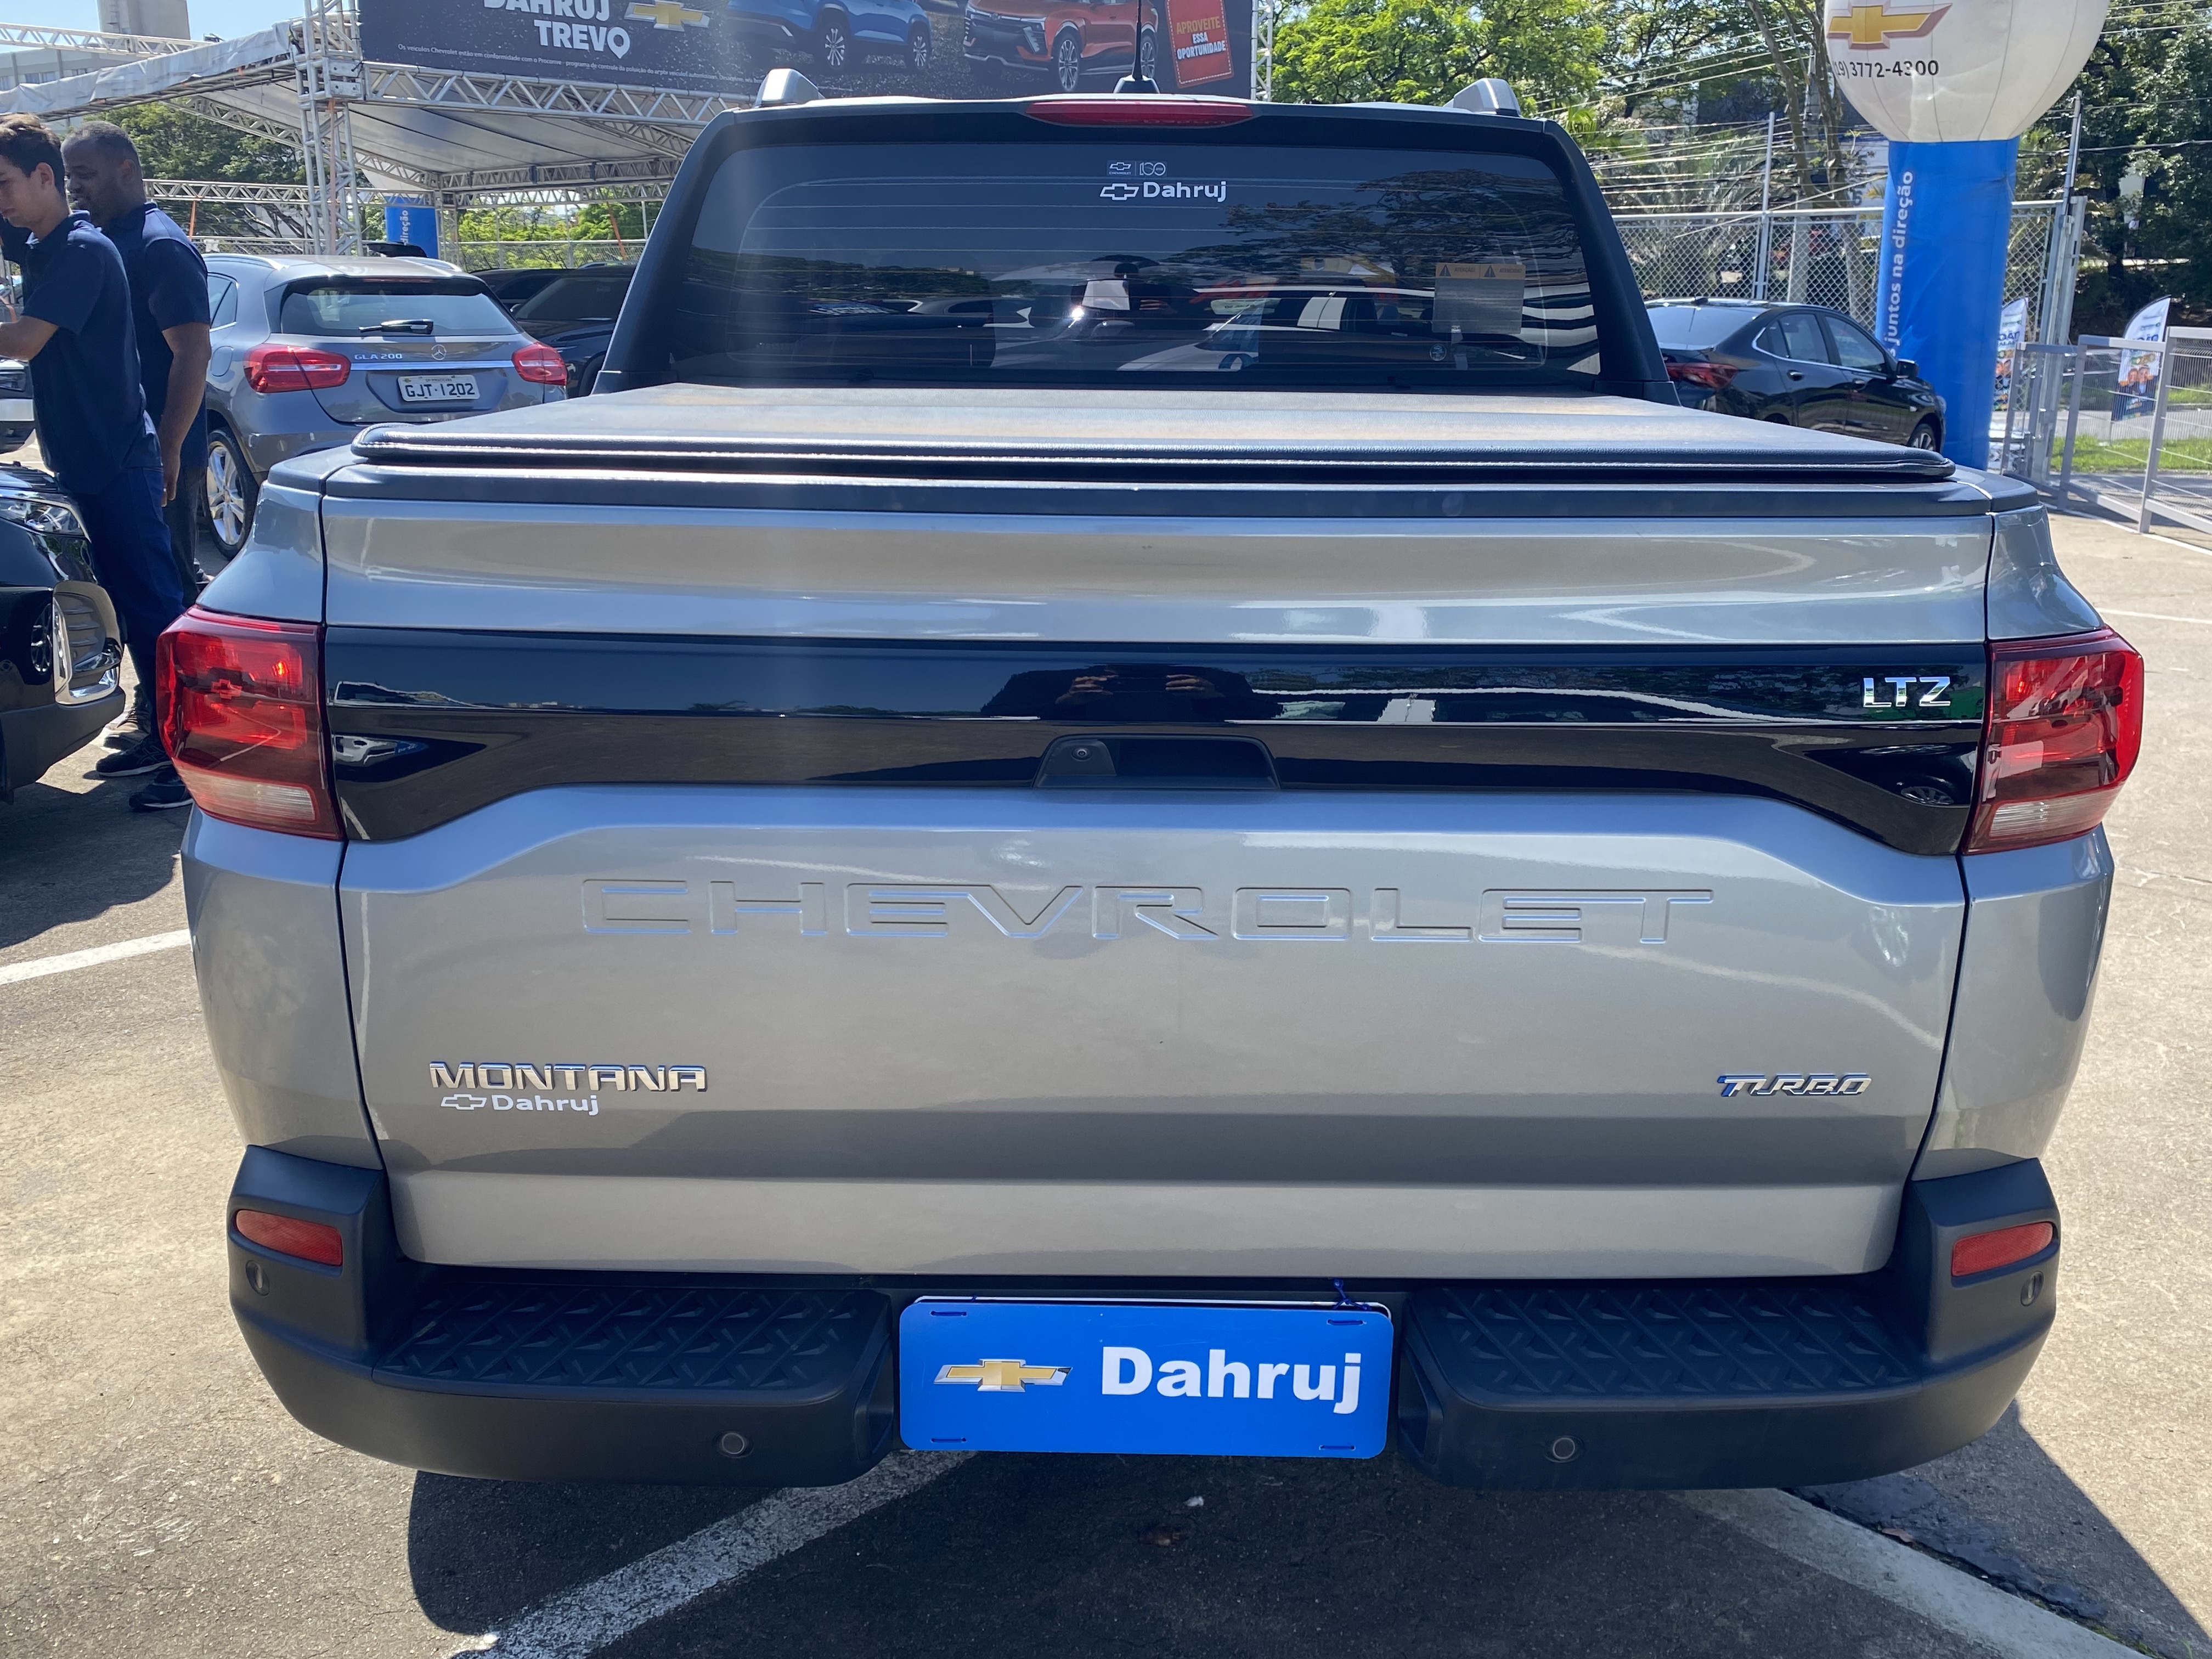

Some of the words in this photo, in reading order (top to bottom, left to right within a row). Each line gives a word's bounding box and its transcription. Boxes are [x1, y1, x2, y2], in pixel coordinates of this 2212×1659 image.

[1176, 16, 1221, 35] APROVEITE
[1192, 32, 1209, 44] ESSA
[533, 19, 630, 59] TREVO
[1177, 40, 1226, 60] OPORTUNIDADE
[1849, 60, 1939, 78] 3772-4300
[1143, 181, 1226, 202] Dahruj
[1892, 171, 1914, 249] direção
[1893, 253, 1904, 278] na
[1884, 283, 1901, 347] juntos
[1863, 676, 1951, 707] LTZ
[582, 878, 1714, 943] CHEVROLET
[429, 1061, 708, 1092] MONTANA
[1717, 1073, 1872, 1097] TURBO
[491, 1094, 600, 1116] Dahruj
[1101, 1346, 1363, 1415] Dahruj
